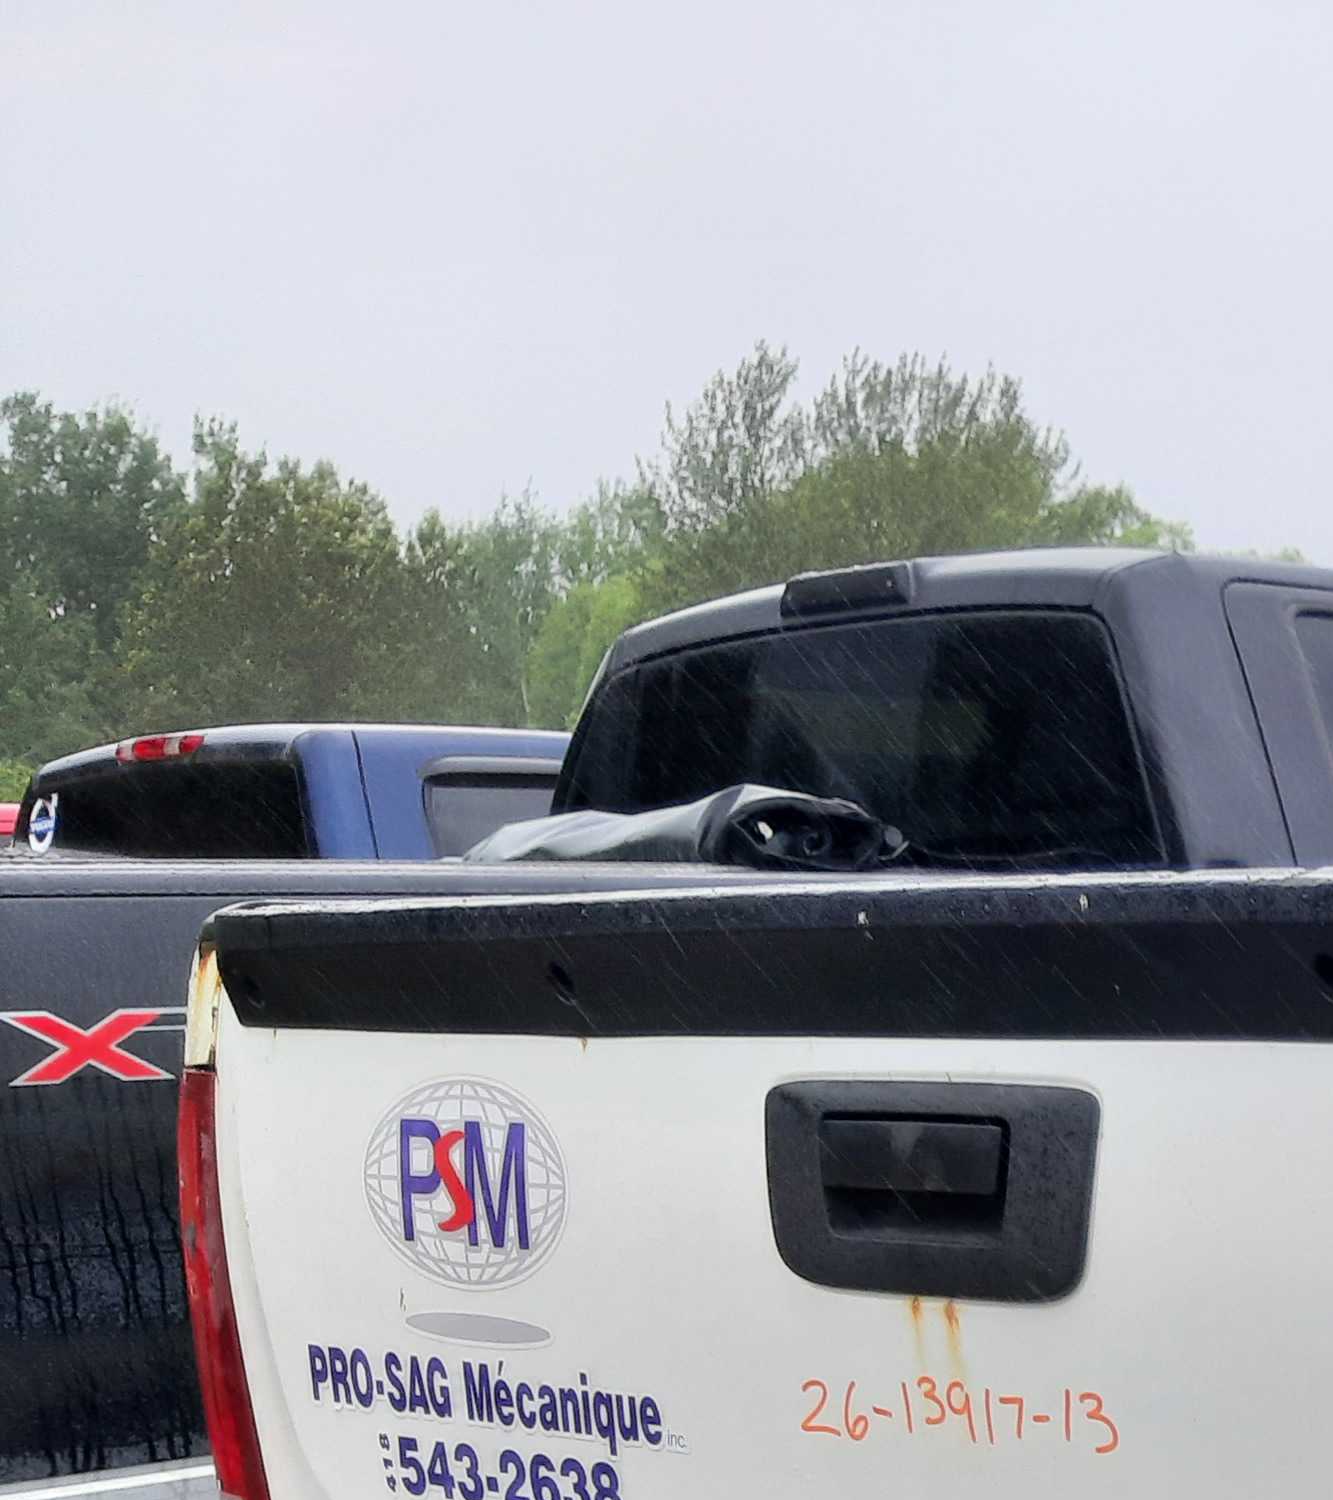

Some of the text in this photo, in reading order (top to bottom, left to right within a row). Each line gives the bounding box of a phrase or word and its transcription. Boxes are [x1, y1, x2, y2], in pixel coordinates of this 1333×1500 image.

[400, 1117, 531, 1252] PSM
[308, 1344, 453, 1418] PRO-SAG
[462, 1360, 663, 1456] Mécanique
[800, 1377, 1119, 1453] 26-13917-13
